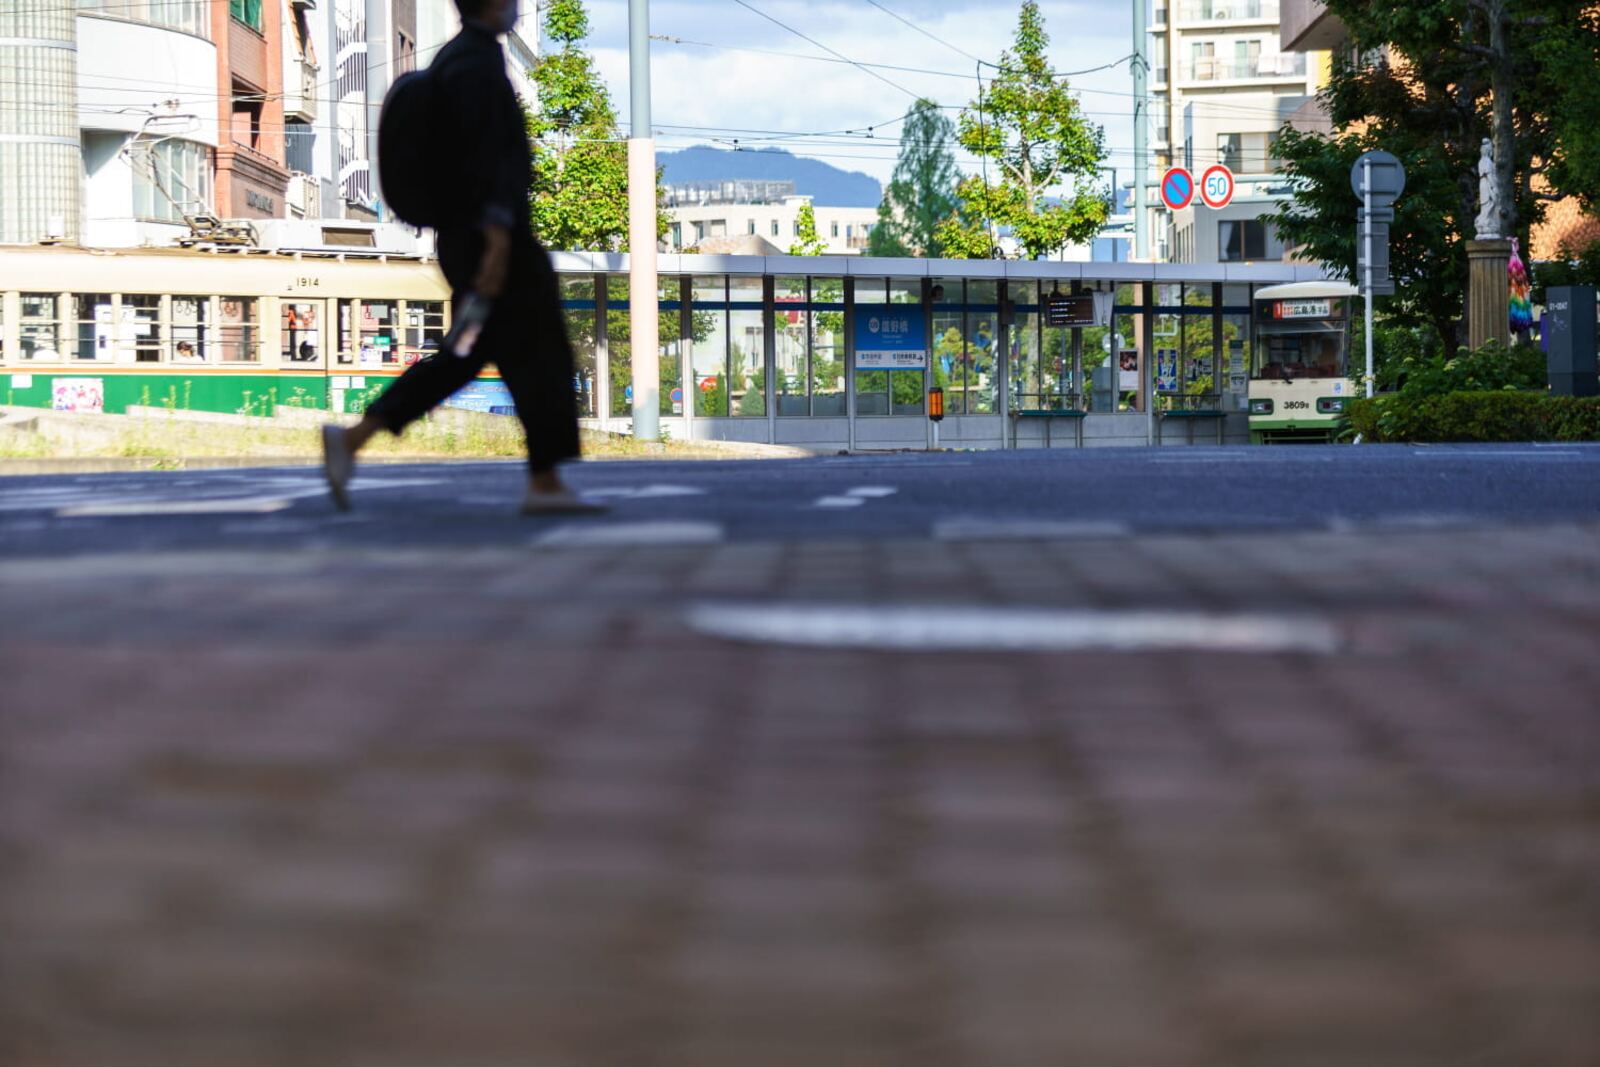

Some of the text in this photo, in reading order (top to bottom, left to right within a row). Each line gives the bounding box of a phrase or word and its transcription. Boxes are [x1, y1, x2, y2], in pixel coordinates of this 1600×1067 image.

[1207, 177, 1227, 196] 50
[296, 277, 319, 288] 1914
[1294, 305, 1316, 315] 広島港
